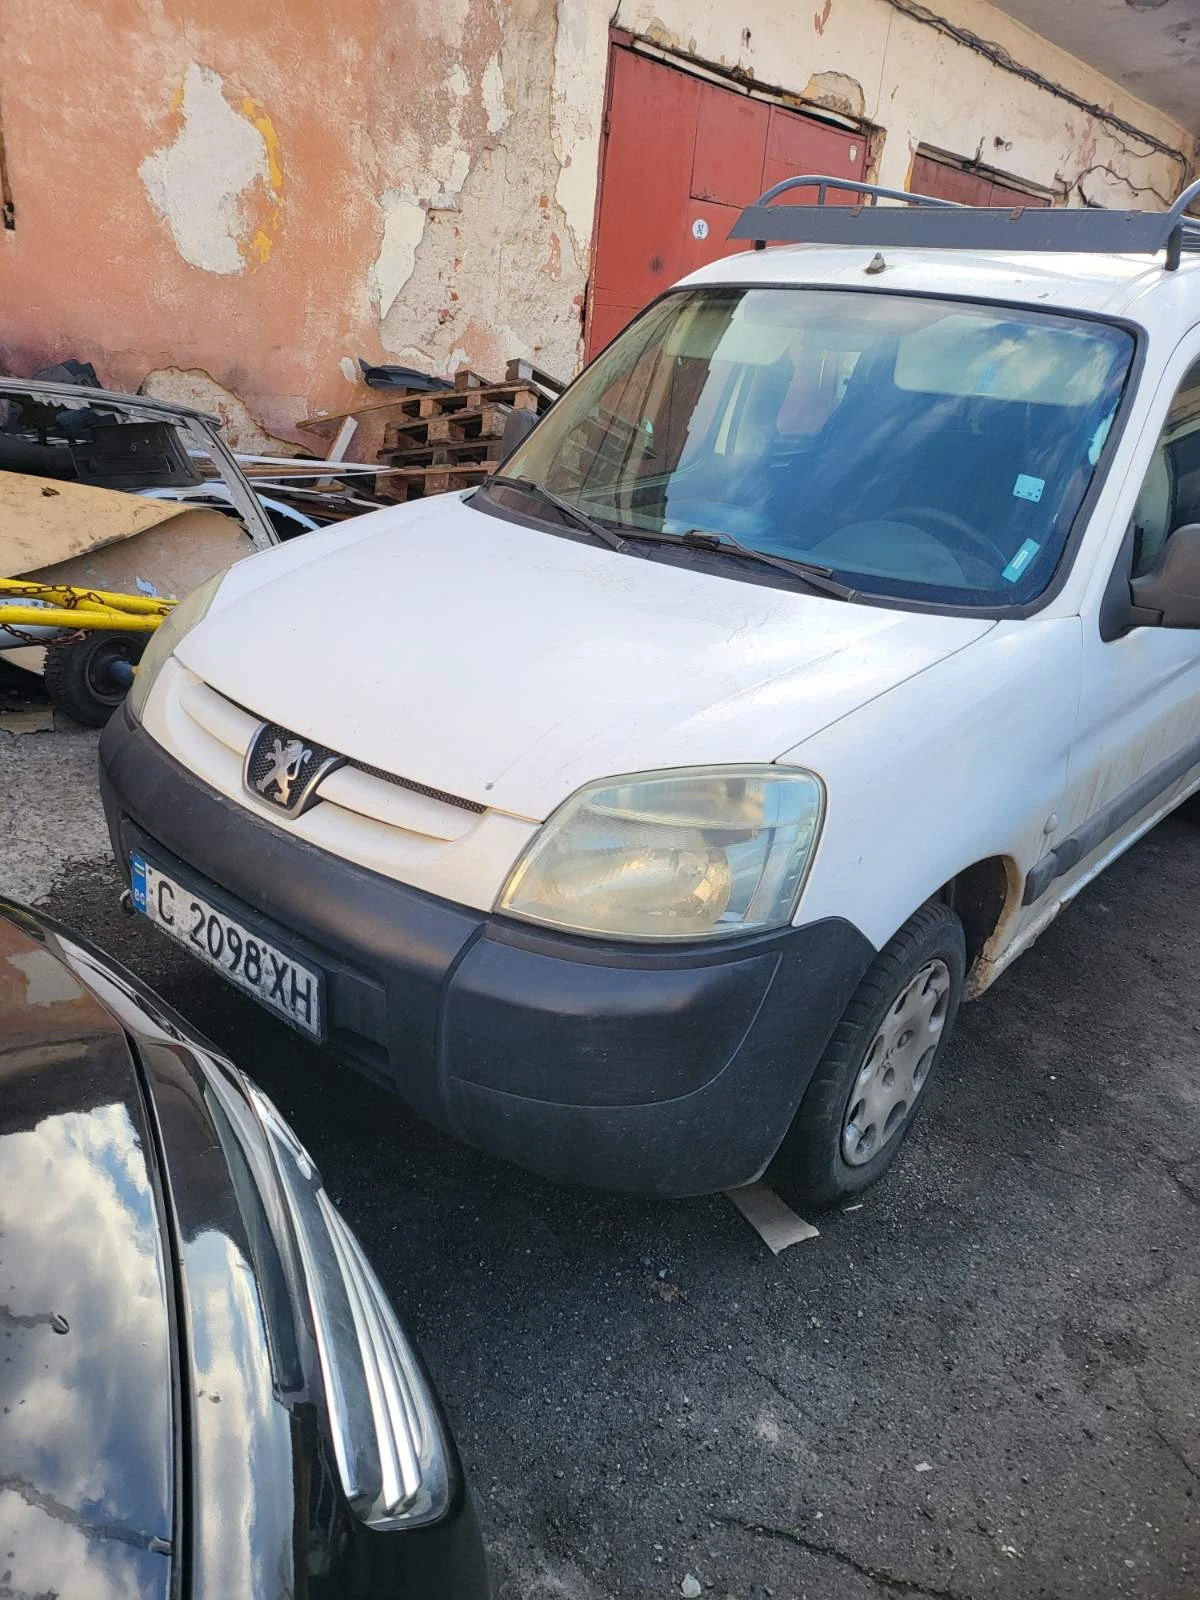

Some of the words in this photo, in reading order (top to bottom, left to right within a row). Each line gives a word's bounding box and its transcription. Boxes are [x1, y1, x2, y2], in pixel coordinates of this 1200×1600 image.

[158, 880, 175, 926] C
[189, 902, 263, 987] 2098
[269, 954, 312, 1025] XH
